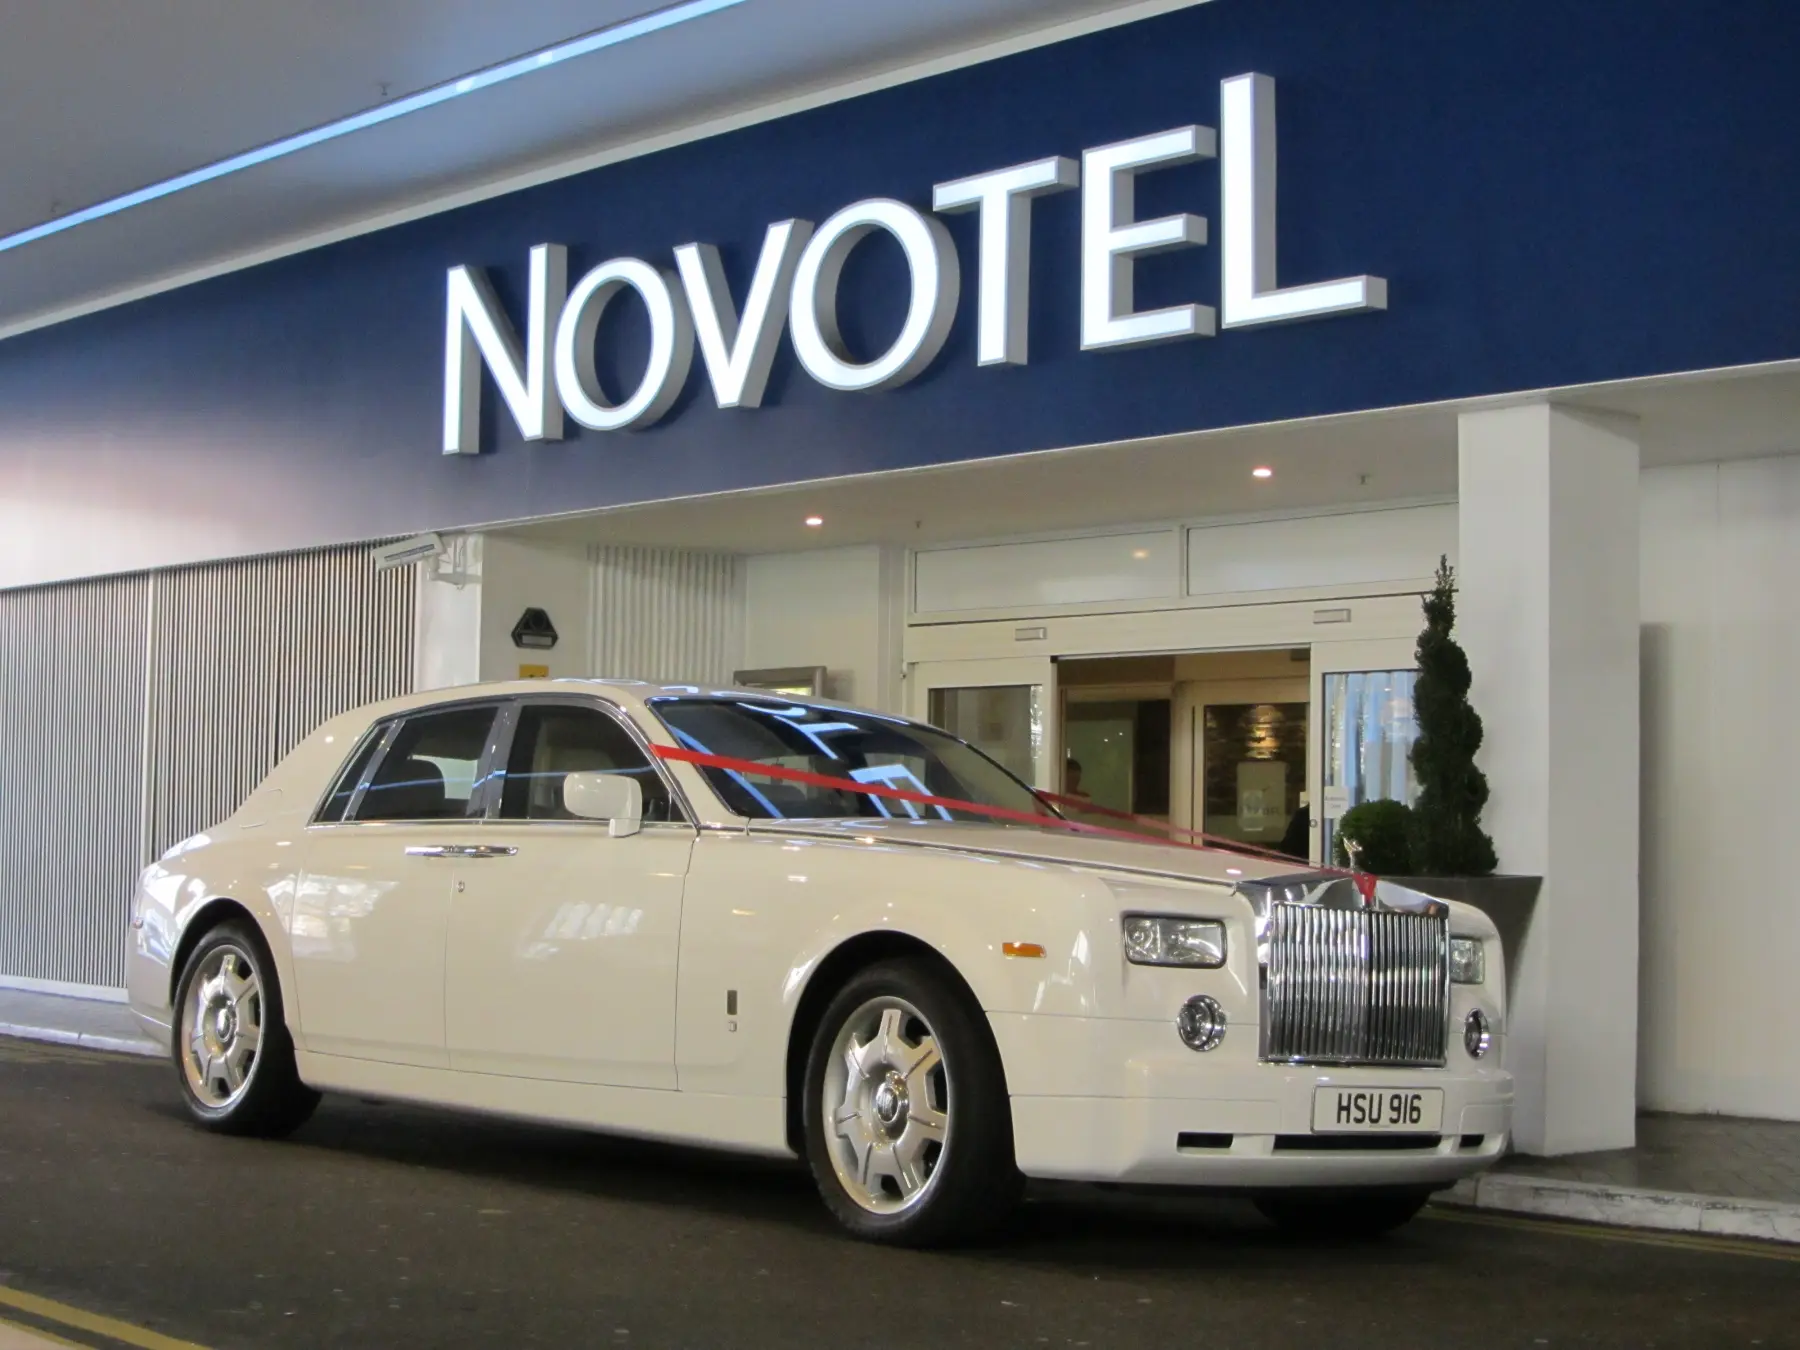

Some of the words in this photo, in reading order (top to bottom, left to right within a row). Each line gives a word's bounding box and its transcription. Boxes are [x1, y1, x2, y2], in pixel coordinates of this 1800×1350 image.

[442, 72, 1388, 456] NOVOTEL
[1336, 1092, 1383, 1124] HSU
[1388, 1093, 1422, 1124] 916
